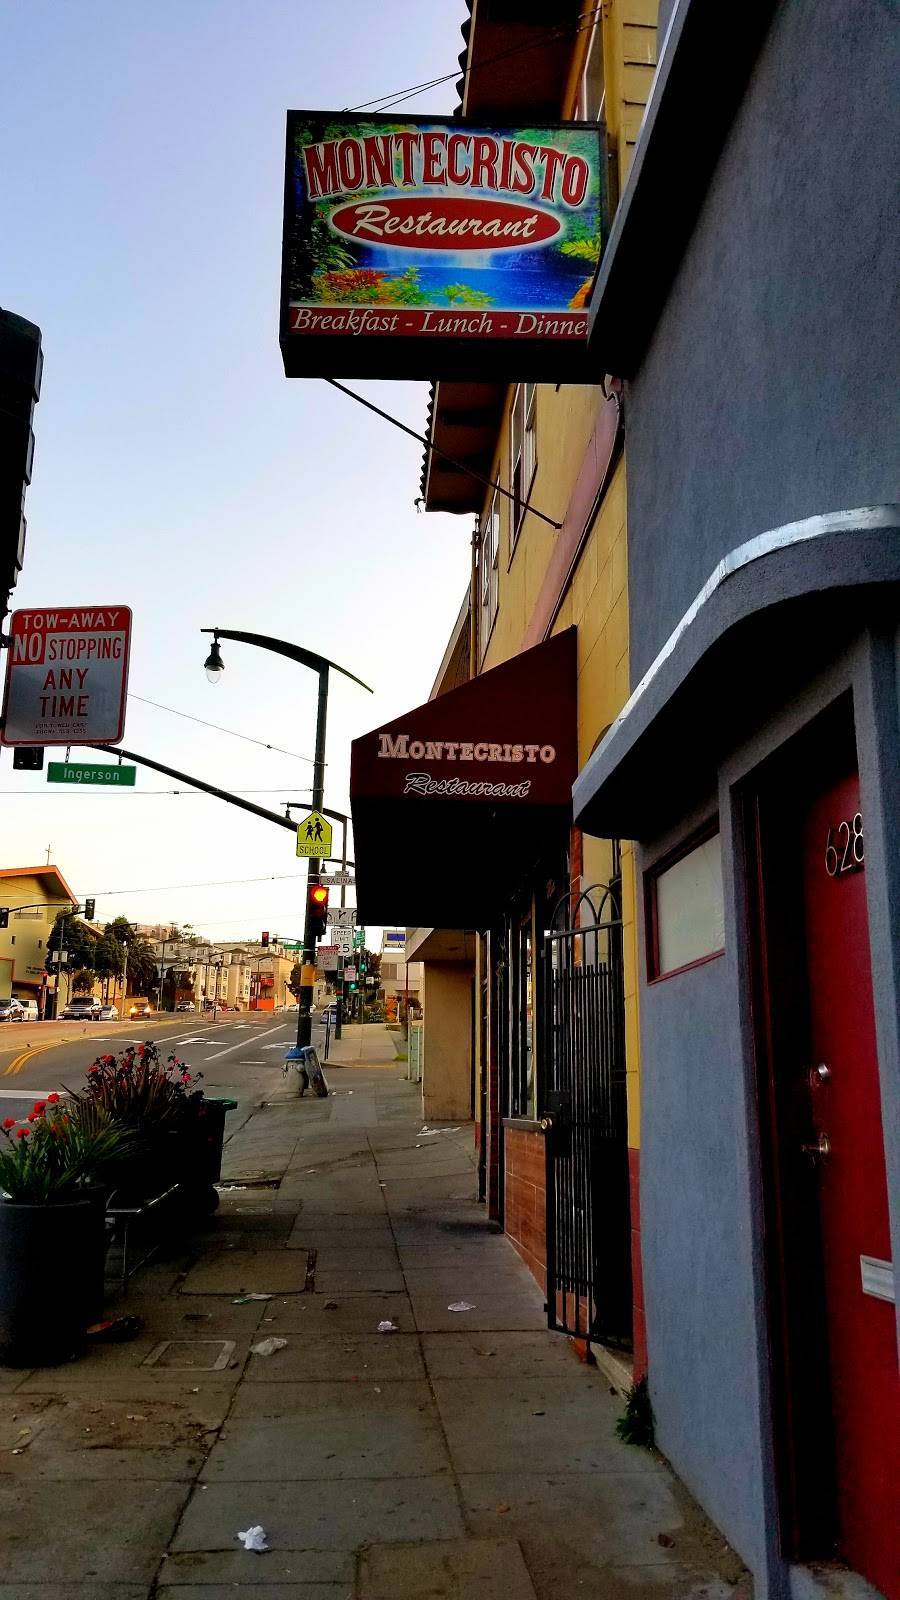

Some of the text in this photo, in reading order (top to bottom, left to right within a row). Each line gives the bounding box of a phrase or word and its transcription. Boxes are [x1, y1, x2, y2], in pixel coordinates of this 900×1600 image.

[302, 131, 590, 207] MONTECRISTO
[352, 204, 538, 239] Restaurant
[292, 309, 400, 335] Breakfast
[419, 312, 493, 334] Lunch
[22, 611, 121, 630] TOW-AWAY
[13, 632, 122, 662] NO STOPPING
[42, 668, 89, 690] ANY
[39, 695, 90, 718] TIME
[377, 733, 556, 764] MONTECRISTO
[63, 767, 120, 784] Ingerson
[403, 772, 531, 798] Restaurant
[299, 846, 329, 855] SCHOOL
[825, 812, 864, 876] 628
